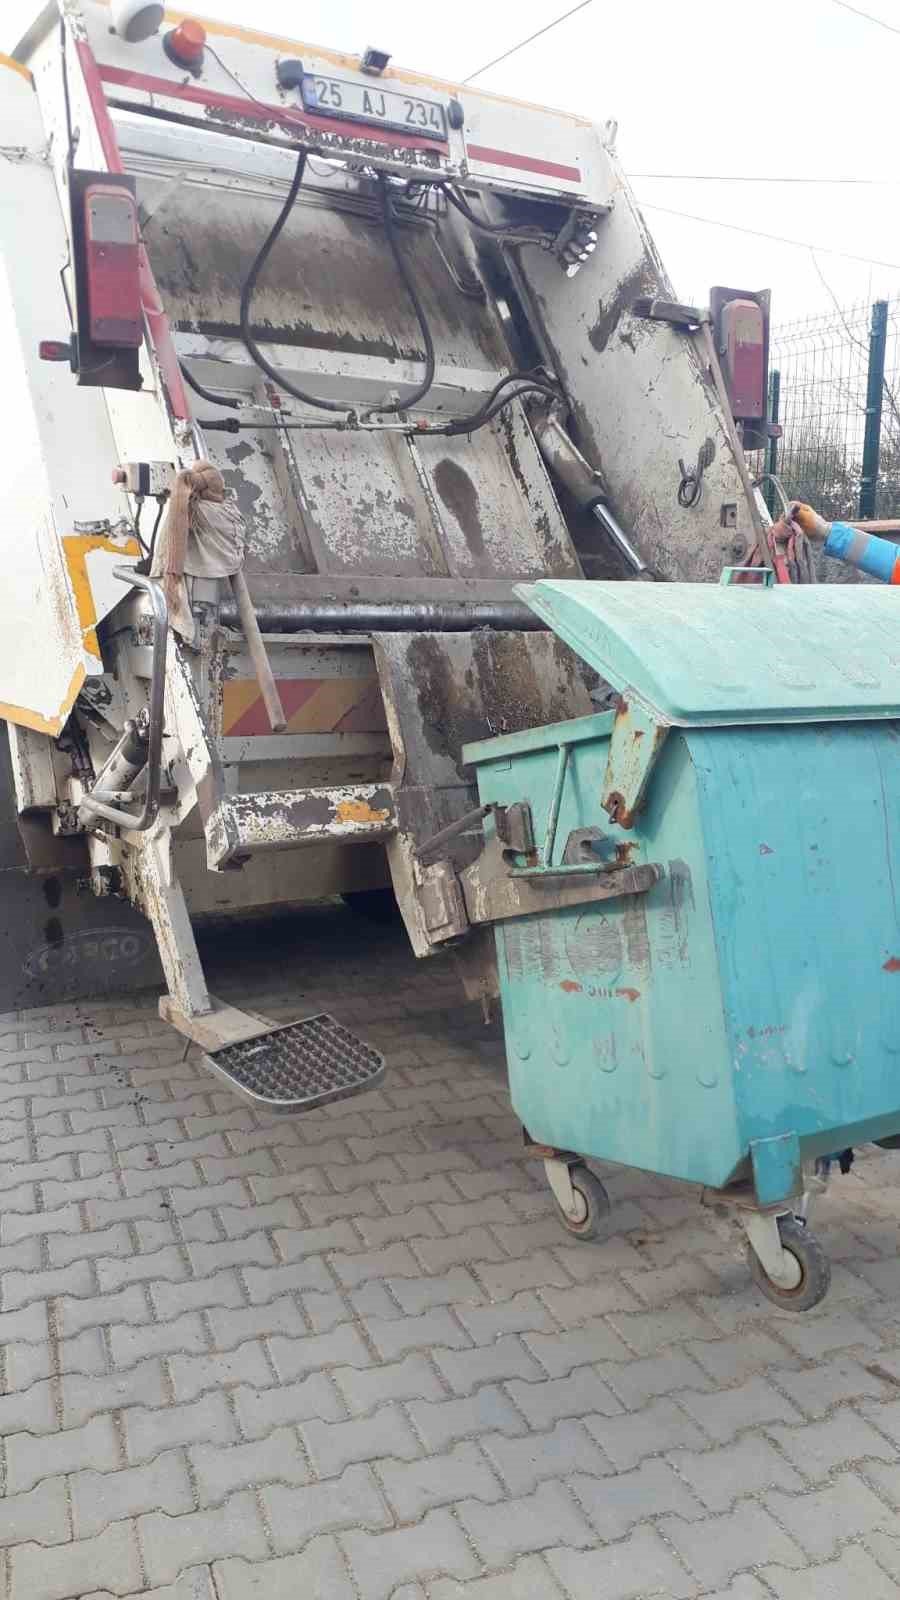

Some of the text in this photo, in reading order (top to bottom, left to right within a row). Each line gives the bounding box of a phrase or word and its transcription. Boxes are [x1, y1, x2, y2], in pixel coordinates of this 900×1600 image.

[316, 80, 440, 130] 25 AJ 234
